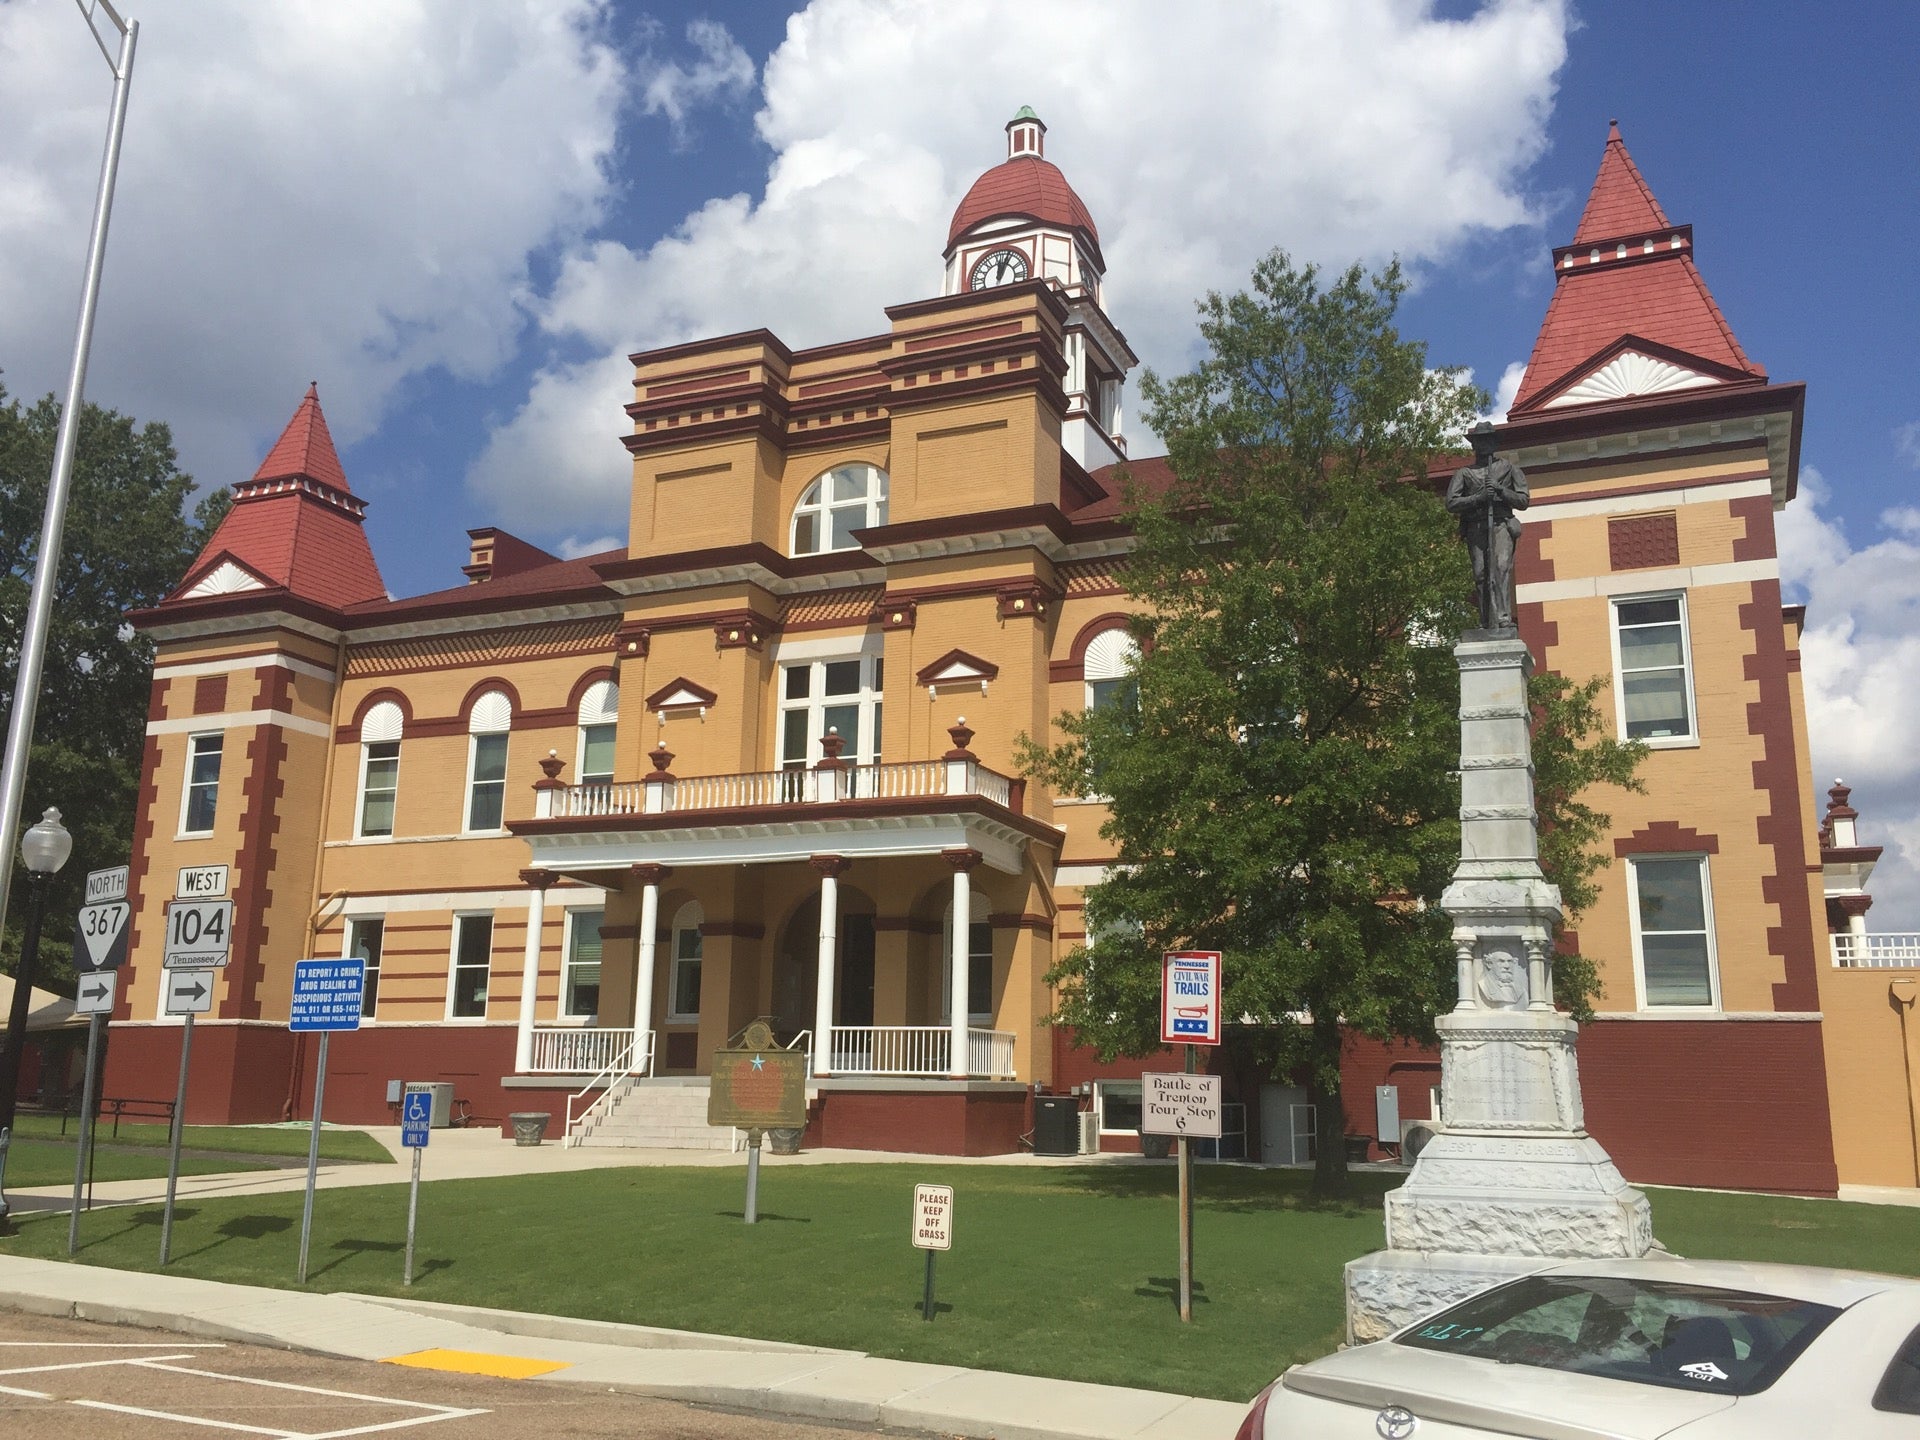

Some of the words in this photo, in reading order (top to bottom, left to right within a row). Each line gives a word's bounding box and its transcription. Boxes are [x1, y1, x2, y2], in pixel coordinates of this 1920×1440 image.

[88, 873, 125, 896] NORTH
[185, 872, 221, 891] WEST
[86, 906, 122, 936] 367
[174, 908, 224, 945] 104
[172, 955, 215, 964] Tennessee
[1174, 960, 1209, 968] TENNESSEE
[298, 968, 306, 978] TO
[308, 967, 332, 978] REPORT
[334, 968, 339, 977] A
[340, 967, 361, 978] CRIME,
[1173, 971, 1193, 981] CIVIL
[1194, 972, 1209, 982] WAR
[300, 981, 318, 990] DRUG
[320, 980, 346, 990] DEALING
[348, 979, 357, 989] OR
[1174, 982, 1209, 996] TRAILS
[293, 993, 332, 1003] SUSPICIOUS
[333, 992, 361, 1002] ACTIVITY
[292, 1006, 306, 1014] DIAL
[308, 1005, 320, 1014] 911
[322, 1005, 331, 1013] OR
[1153, 1078, 1191, 1090] Battle
[1199, 1081, 1212, 1091] of
[1157, 1090, 1207, 1105] Trenton
[1148, 1102, 1179, 1115] Tour
[1187, 1105, 1216, 1120] Stop
[404, 1120, 428, 1131] PARKING
[1175, 1116, 1186, 1129] 6
[407, 1133, 424, 1144] ONLY
[1439, 1142, 1477, 1153] LEST
[1485, 1143, 1506, 1154] WE
[919, 1194, 949, 1204] PLEASE
[923, 1206, 943, 1216] KEEP
[925, 1218, 940, 1227] OFF
[919, 1229, 945, 1240] GRASS
